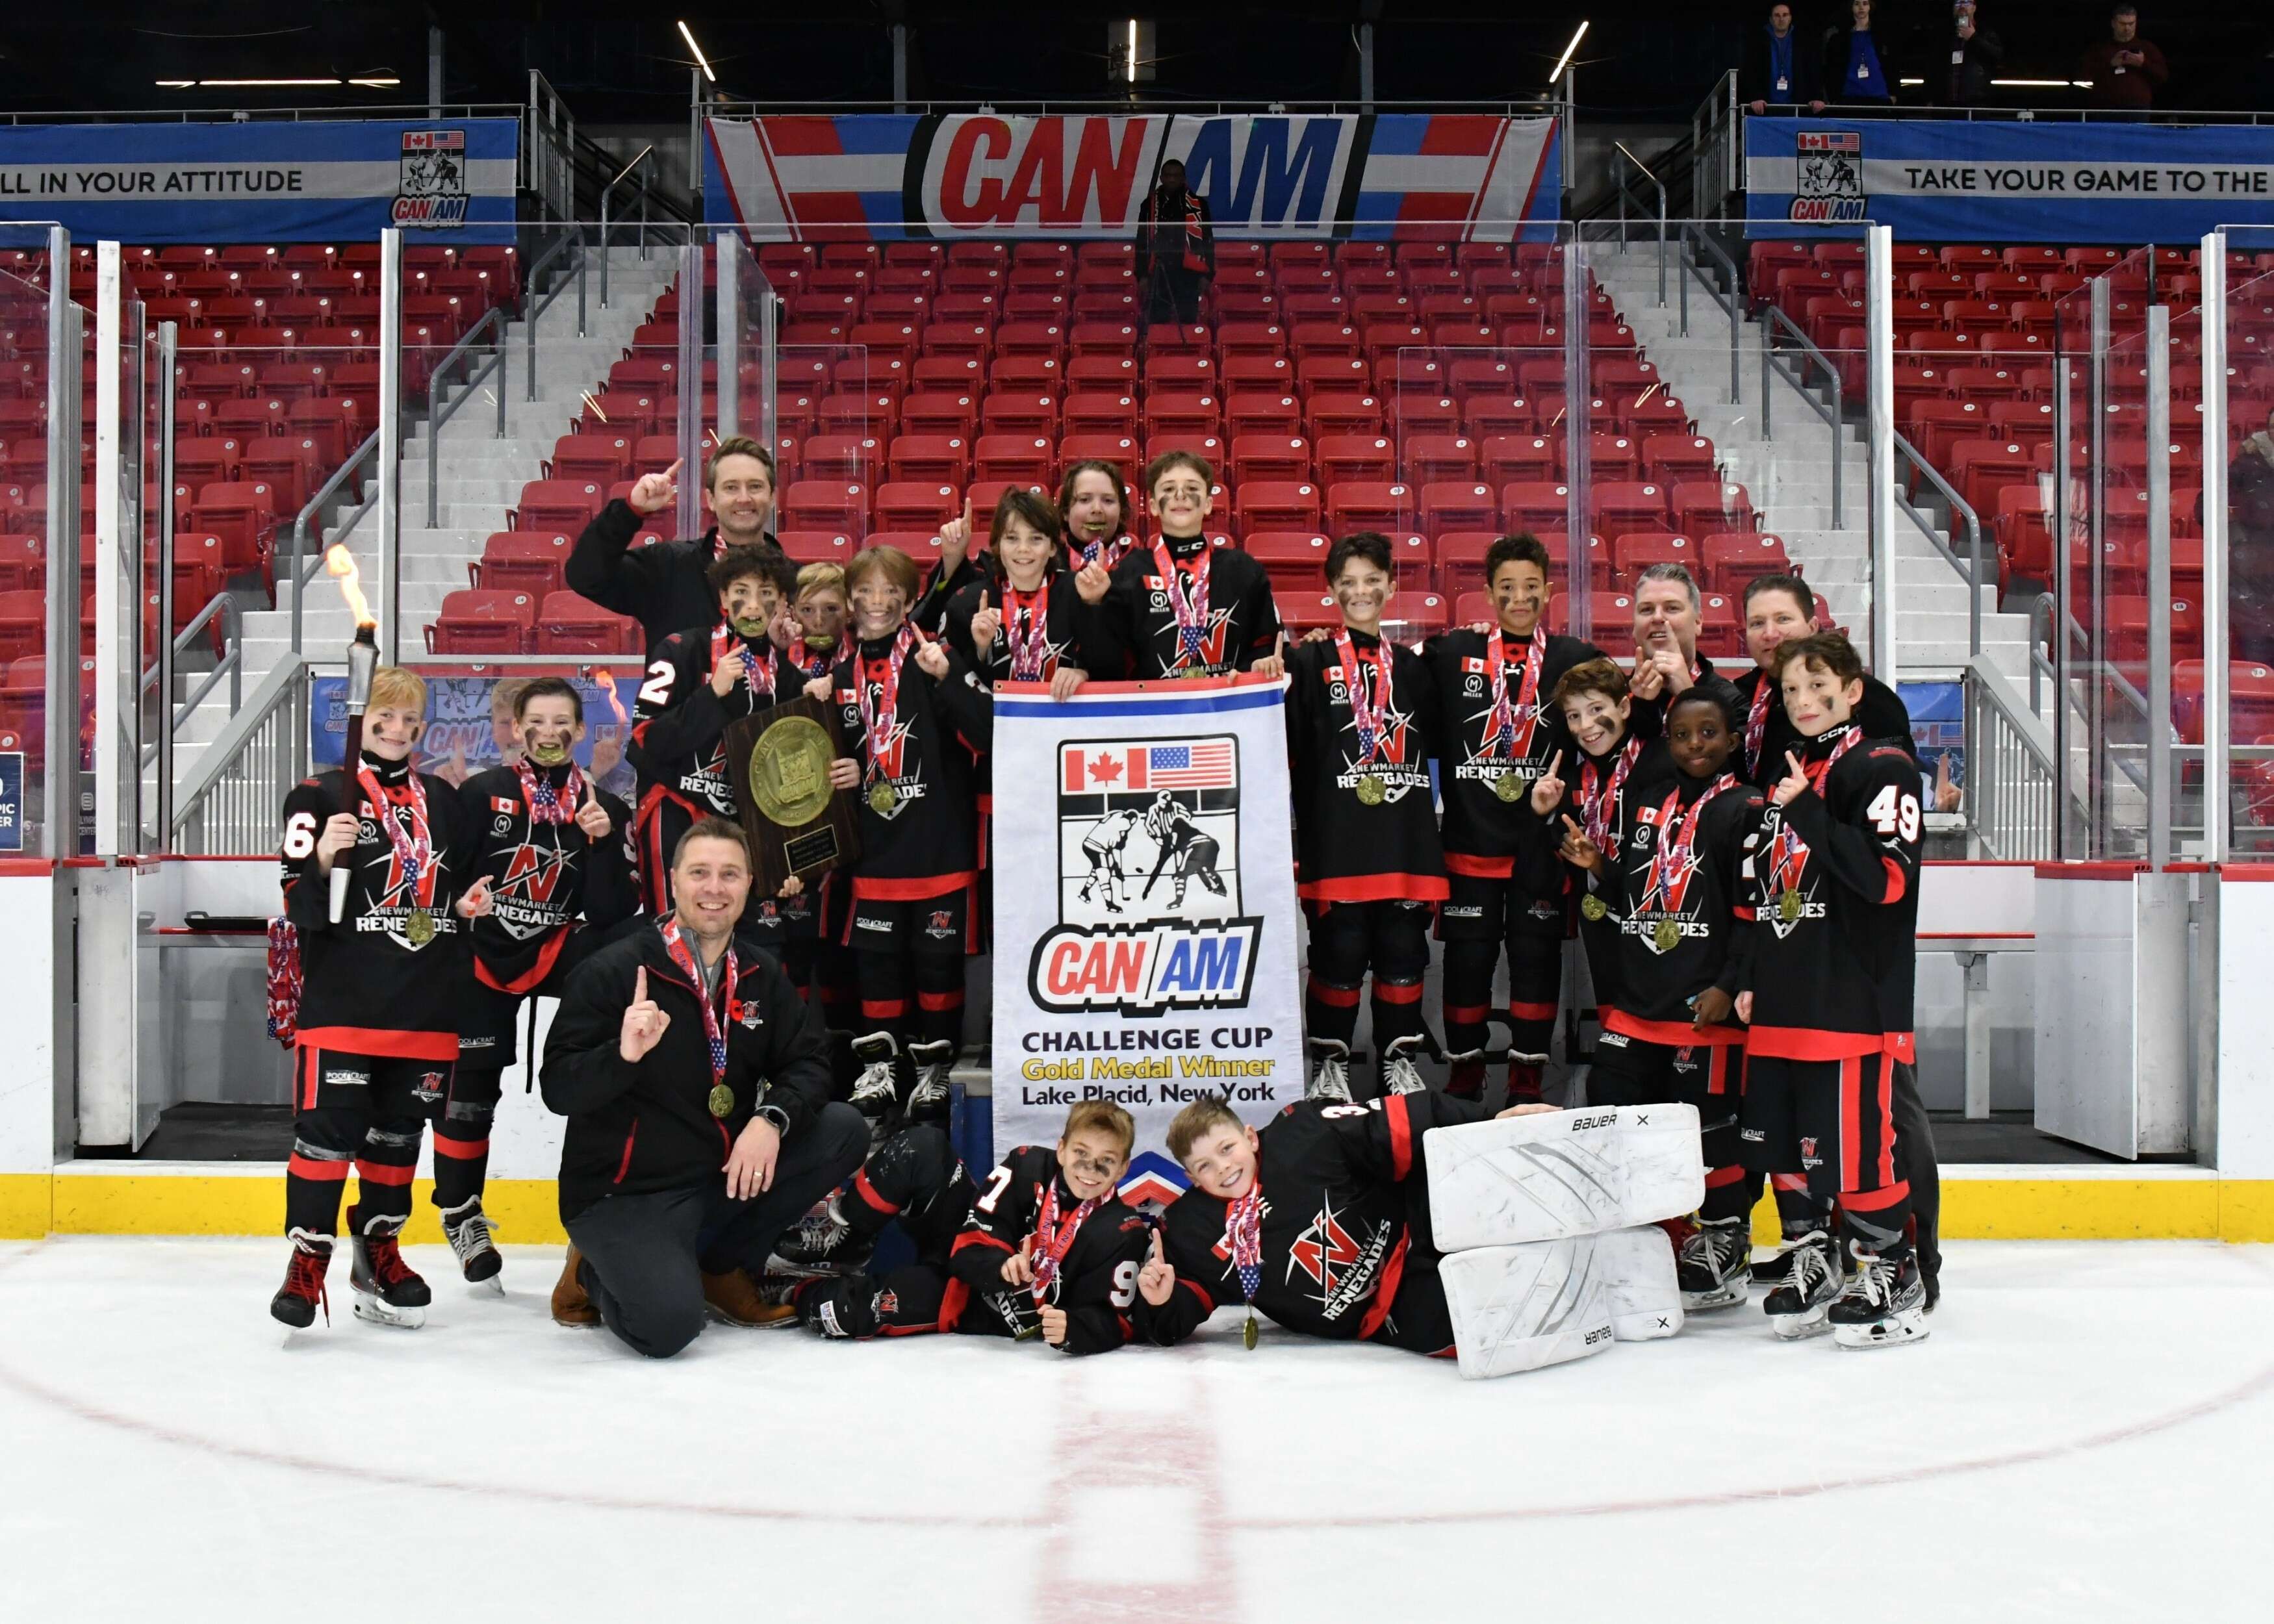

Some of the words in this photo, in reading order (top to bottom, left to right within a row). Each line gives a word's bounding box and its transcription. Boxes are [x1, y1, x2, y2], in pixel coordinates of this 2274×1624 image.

[40, 173, 67, 193] IN
[76, 172, 155, 193] YOUR
[164, 170, 303, 192] ATTITUDE
[1904, 168, 1977, 190] TAKE
[1984, 169, 2067, 191] YOUR
[2075, 170, 2158, 192] GAME
[2166, 171, 2206, 192] TO
[2212, 171, 2268, 193] THE
[637, 660, 676, 705] 2
[1817, 724, 1850, 743] CCM
[1357, 763, 1414, 773] NEWMARKET
[1476, 756, 1540, 766] NEWMARKET
[1866, 784, 1921, 843] 49
[283, 812, 316, 859] 6
[495, 893, 561, 911] NEWMARKET
[1756, 902, 1826, 922] RENEDES
[355, 917, 457, 933] RENEDES
[1620, 920, 1709, 938] RENEDES
[1022, 1028, 1203, 1052] CHALLENGE
[1212, 1026, 1273, 1048] CUP
[1022, 1057, 1084, 1081] Gold
[1092, 1056, 1173, 1080] Medal
[1180, 1055, 1275, 1078] Winner
[1023, 1084, 1076, 1106] Lake
[1083, 1084, 1153, 1106] Placid,
[1160, 1084, 1213, 1103] New
[1220, 1082, 1275, 1101] York
[977, 1165, 1012, 1212] 7
[1321, 1219, 1392, 1321] RENEGADES
[1329, 1234, 1374, 1300] NEWMARKET
[1110, 1260, 1140, 1308] 9
